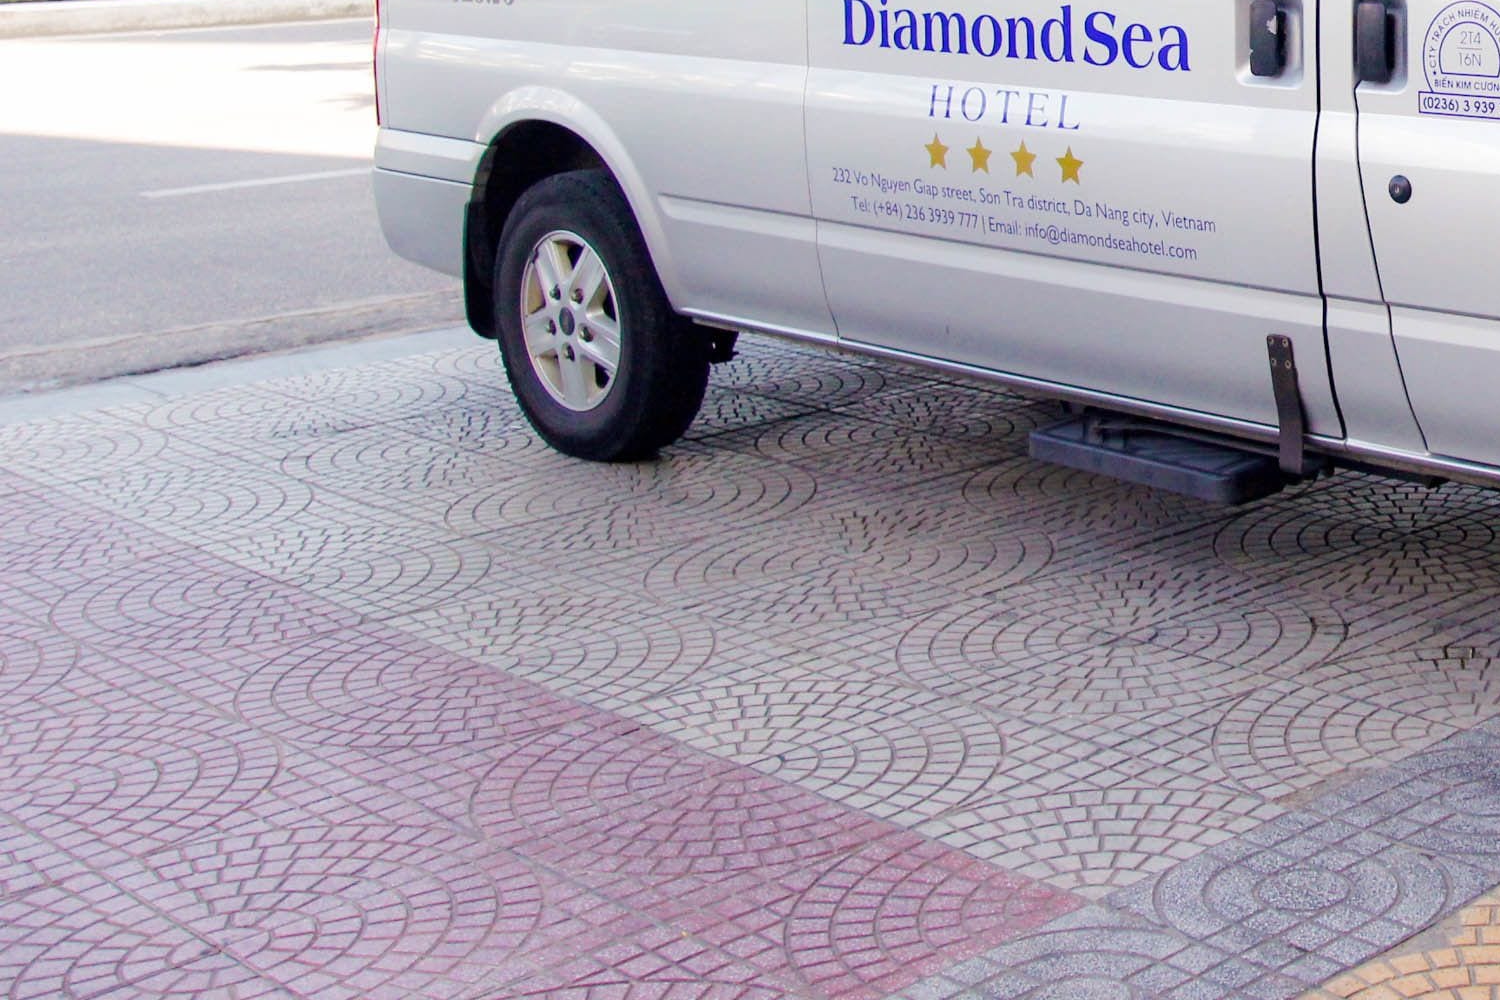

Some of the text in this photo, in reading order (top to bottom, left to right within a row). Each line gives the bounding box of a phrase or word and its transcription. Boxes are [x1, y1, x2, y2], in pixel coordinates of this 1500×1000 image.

[1459, 52, 1482, 67] 16N
[1455, 80, 1471, 90] KIM
[928, 84, 1081, 130] HOTEL
[1423, 96, 1459, 112] (0236)
[1463, 100, 1470, 112] 3
[1474, 101, 1495, 114] 939
[832, 167, 1216, 233] 232 Vo Nguyen Giap street, Son Tra district, Da Nang city, Vietnam
[851, 196, 870, 212] Tel:
[873, 200, 903, 220] (+84)
[906, 204, 926, 221] 236
[929, 207, 955, 225] 3939
[957, 211, 978, 229] 777
[988, 216, 1021, 236] Email:
[1025, 223, 1198, 260] info@diamondseahotel.com
